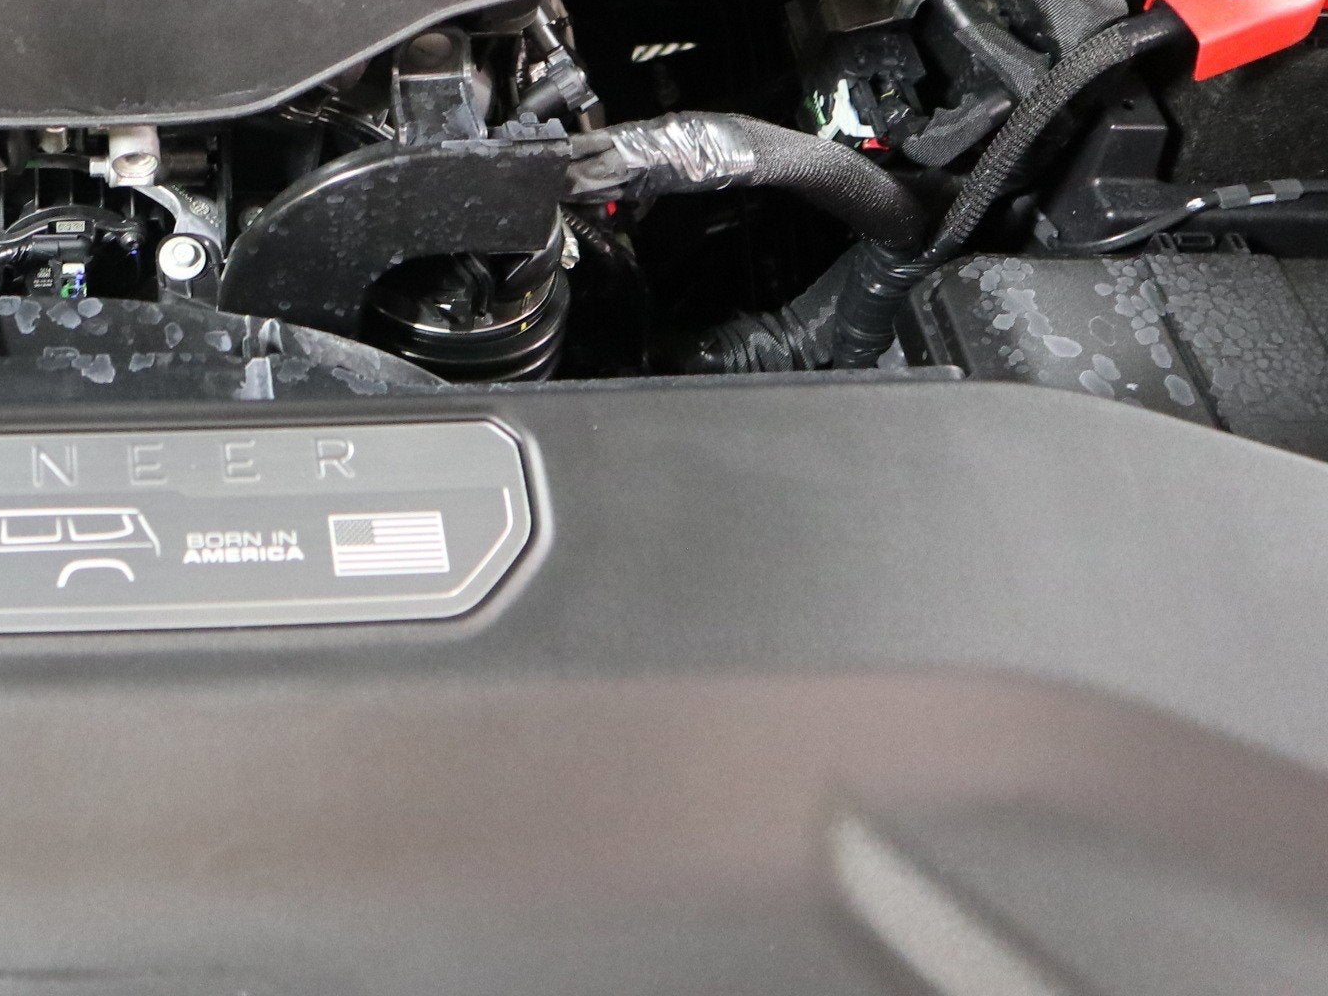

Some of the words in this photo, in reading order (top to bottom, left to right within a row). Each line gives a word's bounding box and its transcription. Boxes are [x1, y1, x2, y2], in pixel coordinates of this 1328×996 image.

[186, 531, 263, 549] BORN
[271, 529, 298, 546] IN
[182, 546, 304, 565] AMERICA
